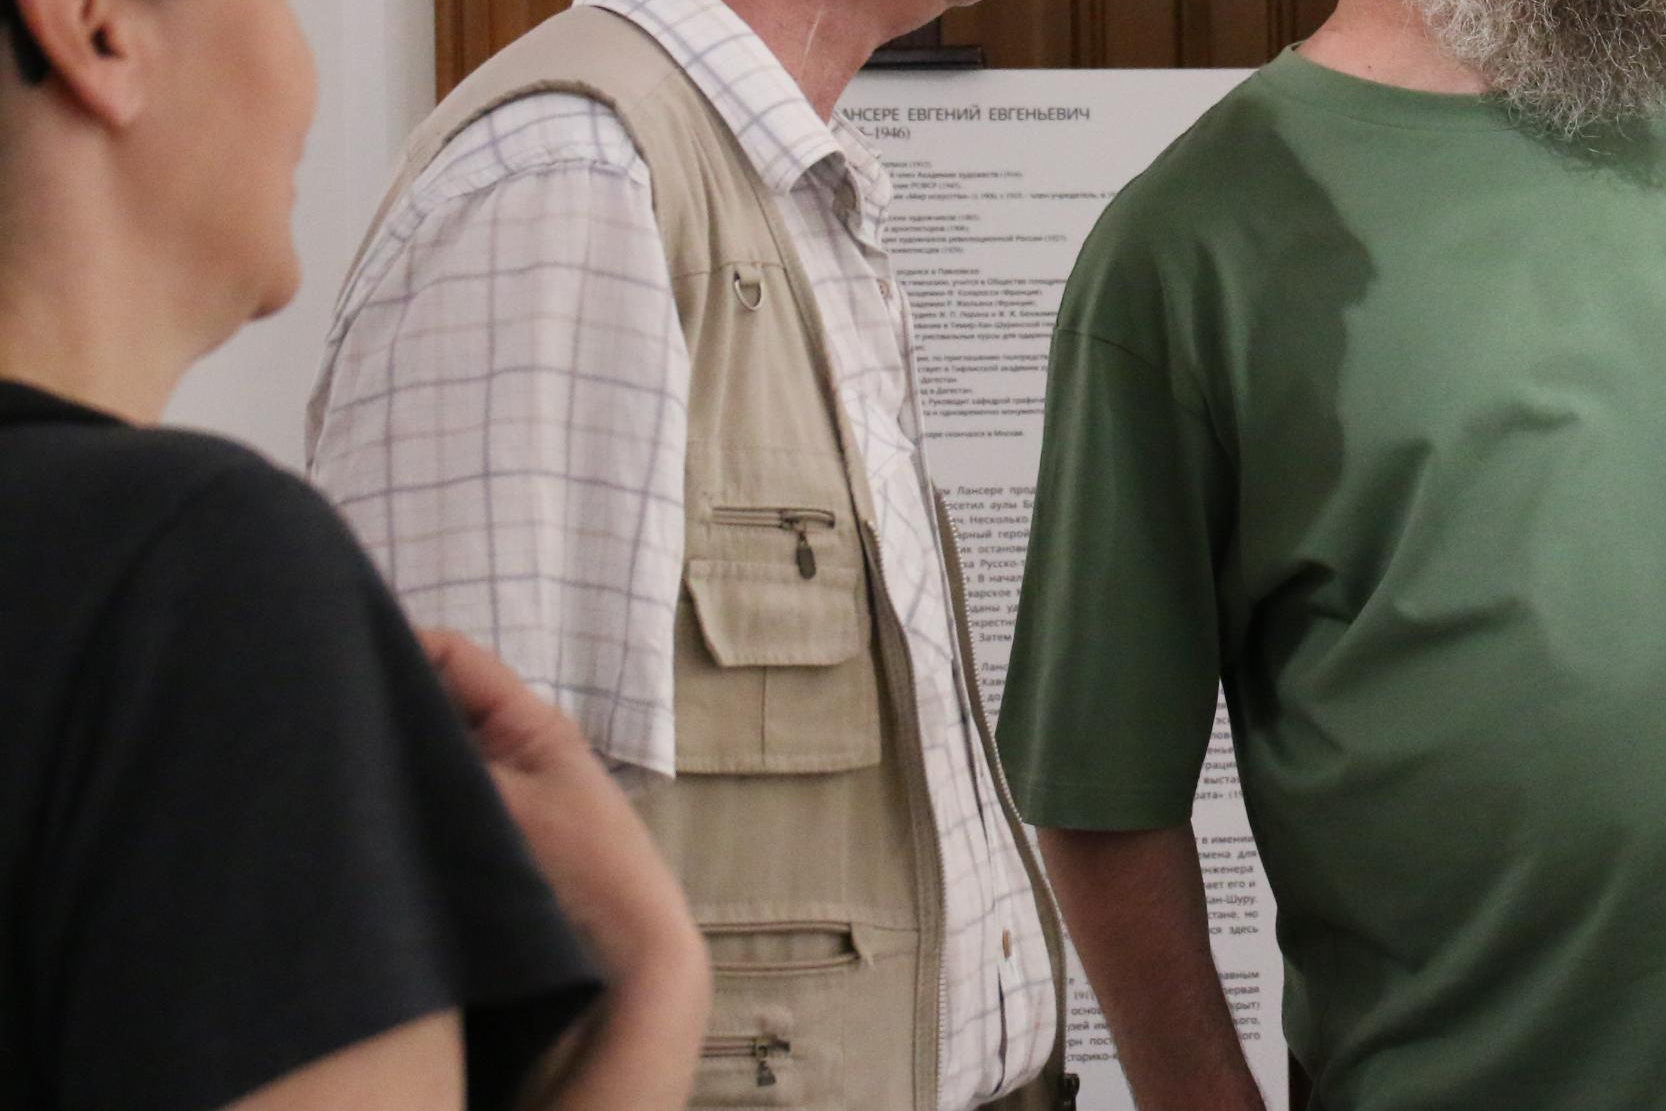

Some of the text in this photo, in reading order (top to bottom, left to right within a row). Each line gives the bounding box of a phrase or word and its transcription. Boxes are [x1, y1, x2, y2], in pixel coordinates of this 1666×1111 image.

[842, 105, 1090, 121] АНСЕРЕ ЕВГЕНИЙ ЕВГЕНЬЕВИЧ
[979, 633, 1012, 642] Затем
